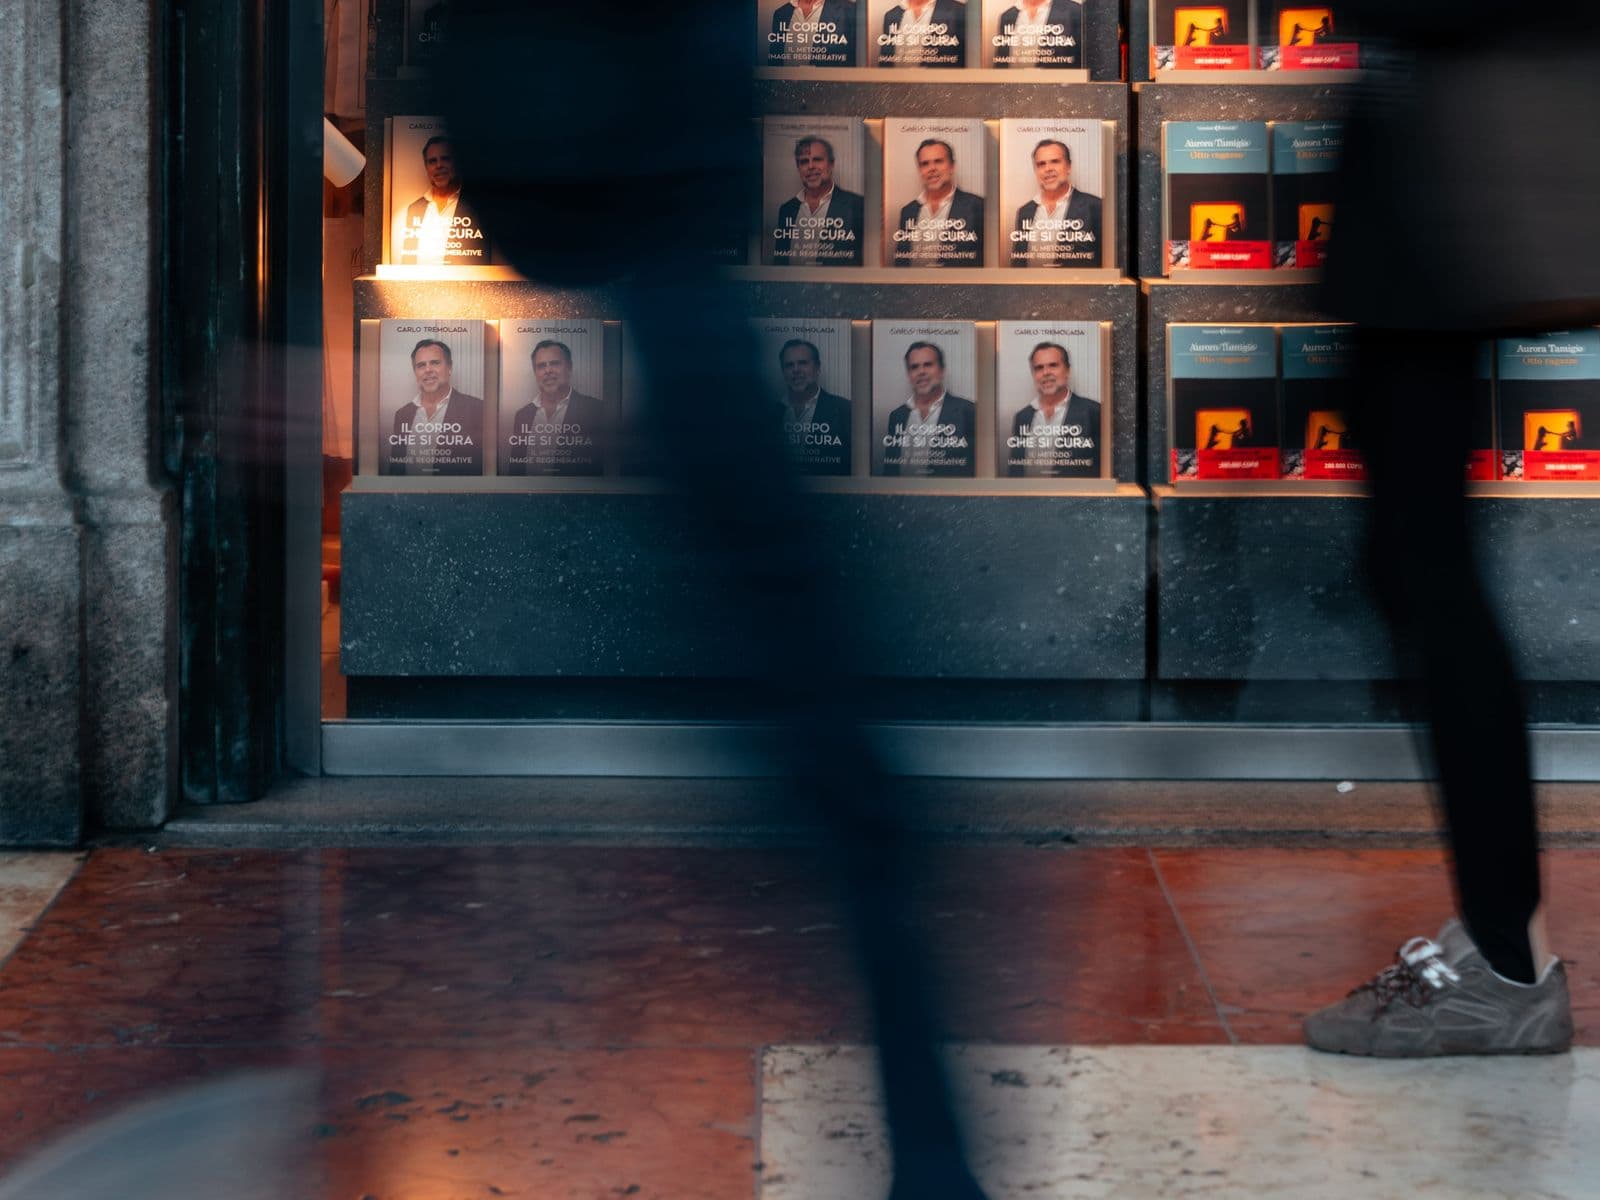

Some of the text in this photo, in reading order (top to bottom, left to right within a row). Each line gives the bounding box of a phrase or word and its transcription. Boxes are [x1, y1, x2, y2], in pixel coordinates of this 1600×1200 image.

[779, 22, 836, 32] IL CORPO
[890, 23, 948, 34] IL CORPO
[1004, 24, 1064, 35] IL CORPO
[768, 33, 848, 45] CHE SI CURA
[877, 35, 959, 46] CHE SI CURA
[992, 36, 1076, 47] CHE SI CURA
[1184, 139, 1214, 148] Aurora
[785, 218, 844, 228] IL CORPO
[906, 218, 966, 230] IL CORPO
[1022, 219, 1084, 230] IL CORPO
[448, 229, 483, 239] CURA
[774, 229, 856, 241] CHE SI CURA
[893, 231, 977, 242] CHE SI CURA
[1010, 231, 1095, 243] CHE SI CURA
[1190, 343, 1219, 352] Aurora
[1517, 344, 1584, 354] Aurora Tamigio
[401, 422, 462, 433] IL CORPO
[521, 423, 581, 434] IL CORPO
[784, 423, 830, 433] CORPO
[895, 423, 956, 435] IL CORPO
[1020, 425, 1082, 436] IL CORPO
[389, 435, 473, 446] CHE SI CURA
[509, 436, 592, 446] CHE SI CURA
[805, 435, 842, 446] CURA
[883, 436, 968, 447] CHE SI CURA
[1007, 437, 1094, 449] CHE SI CURA
